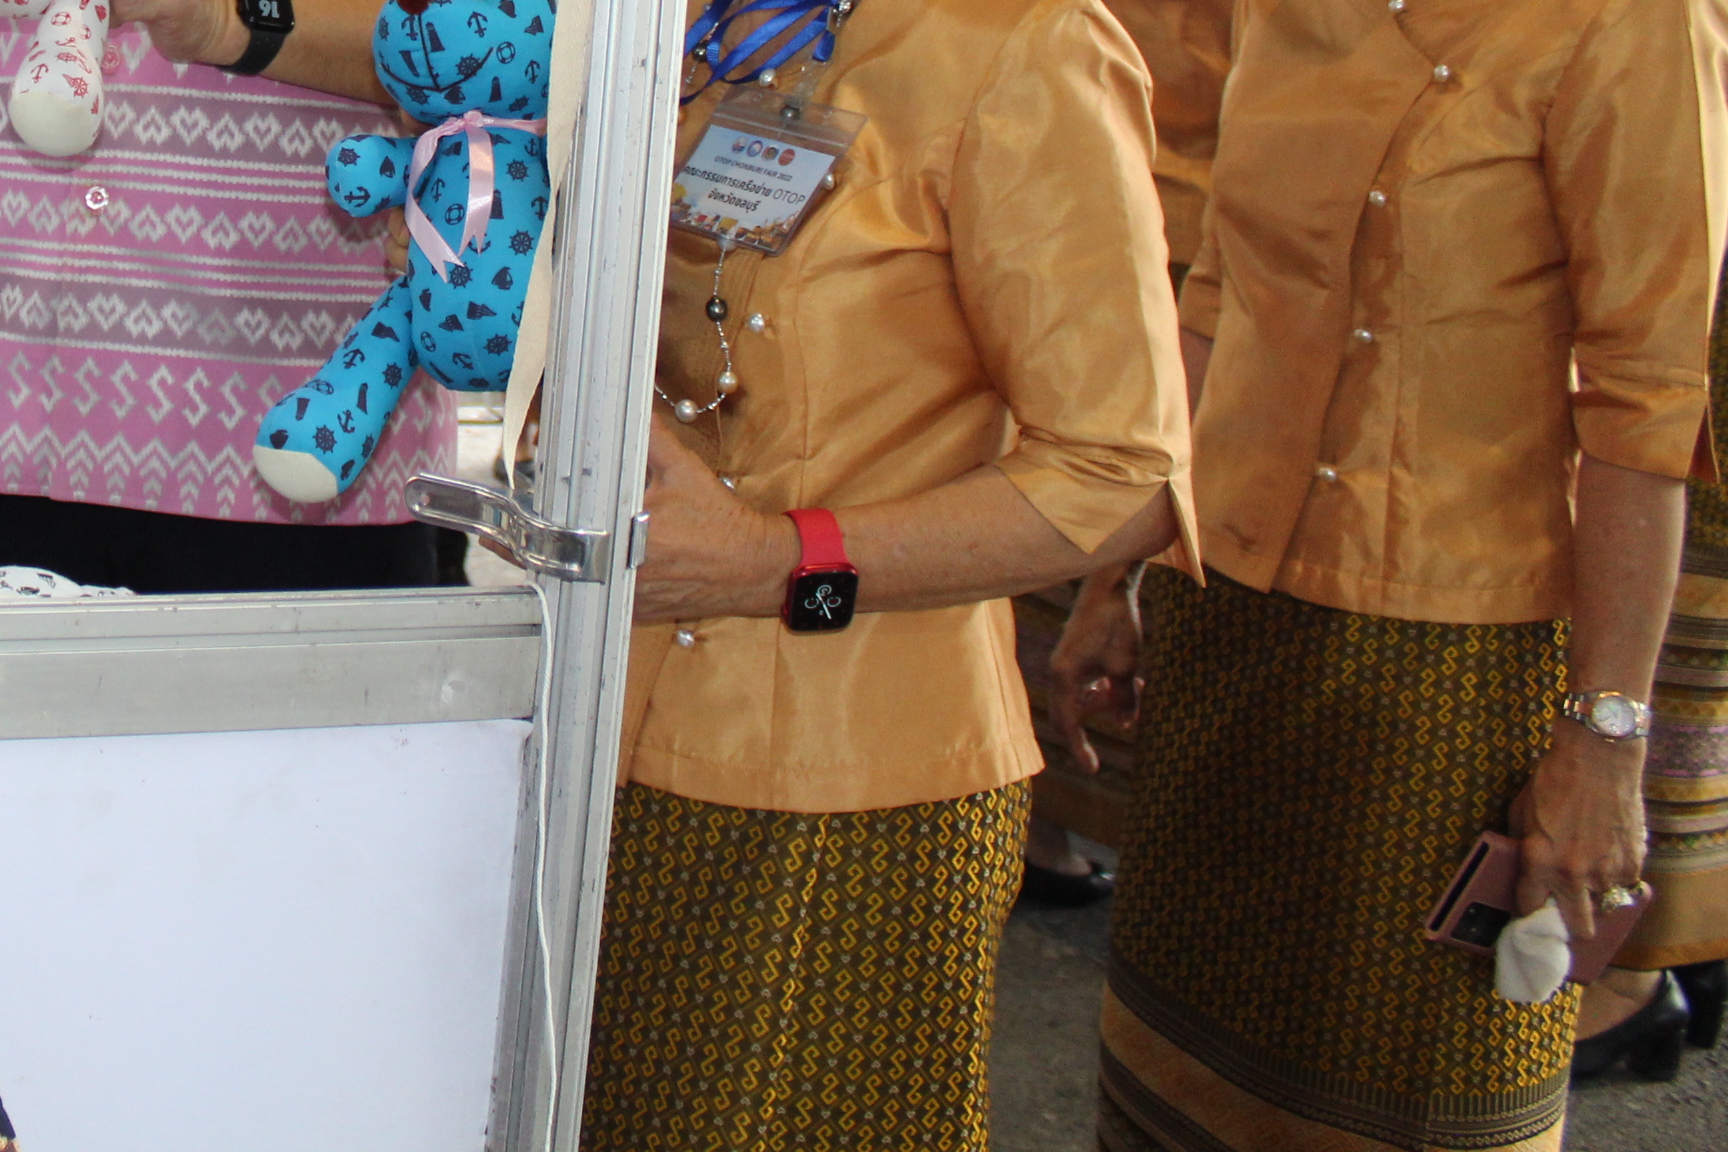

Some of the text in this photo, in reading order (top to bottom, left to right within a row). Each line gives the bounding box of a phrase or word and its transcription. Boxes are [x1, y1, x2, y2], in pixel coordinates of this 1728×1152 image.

[258, 0, 280, 19] 16
[714, 155, 731, 166] OTOP
[730, 159, 763, 175] CHONBURI
[762, 166, 778, 178] FAIR
[708, 188, 762, 214] จังหวัดชลบุรี
[772, 188, 806, 206] OTOP
